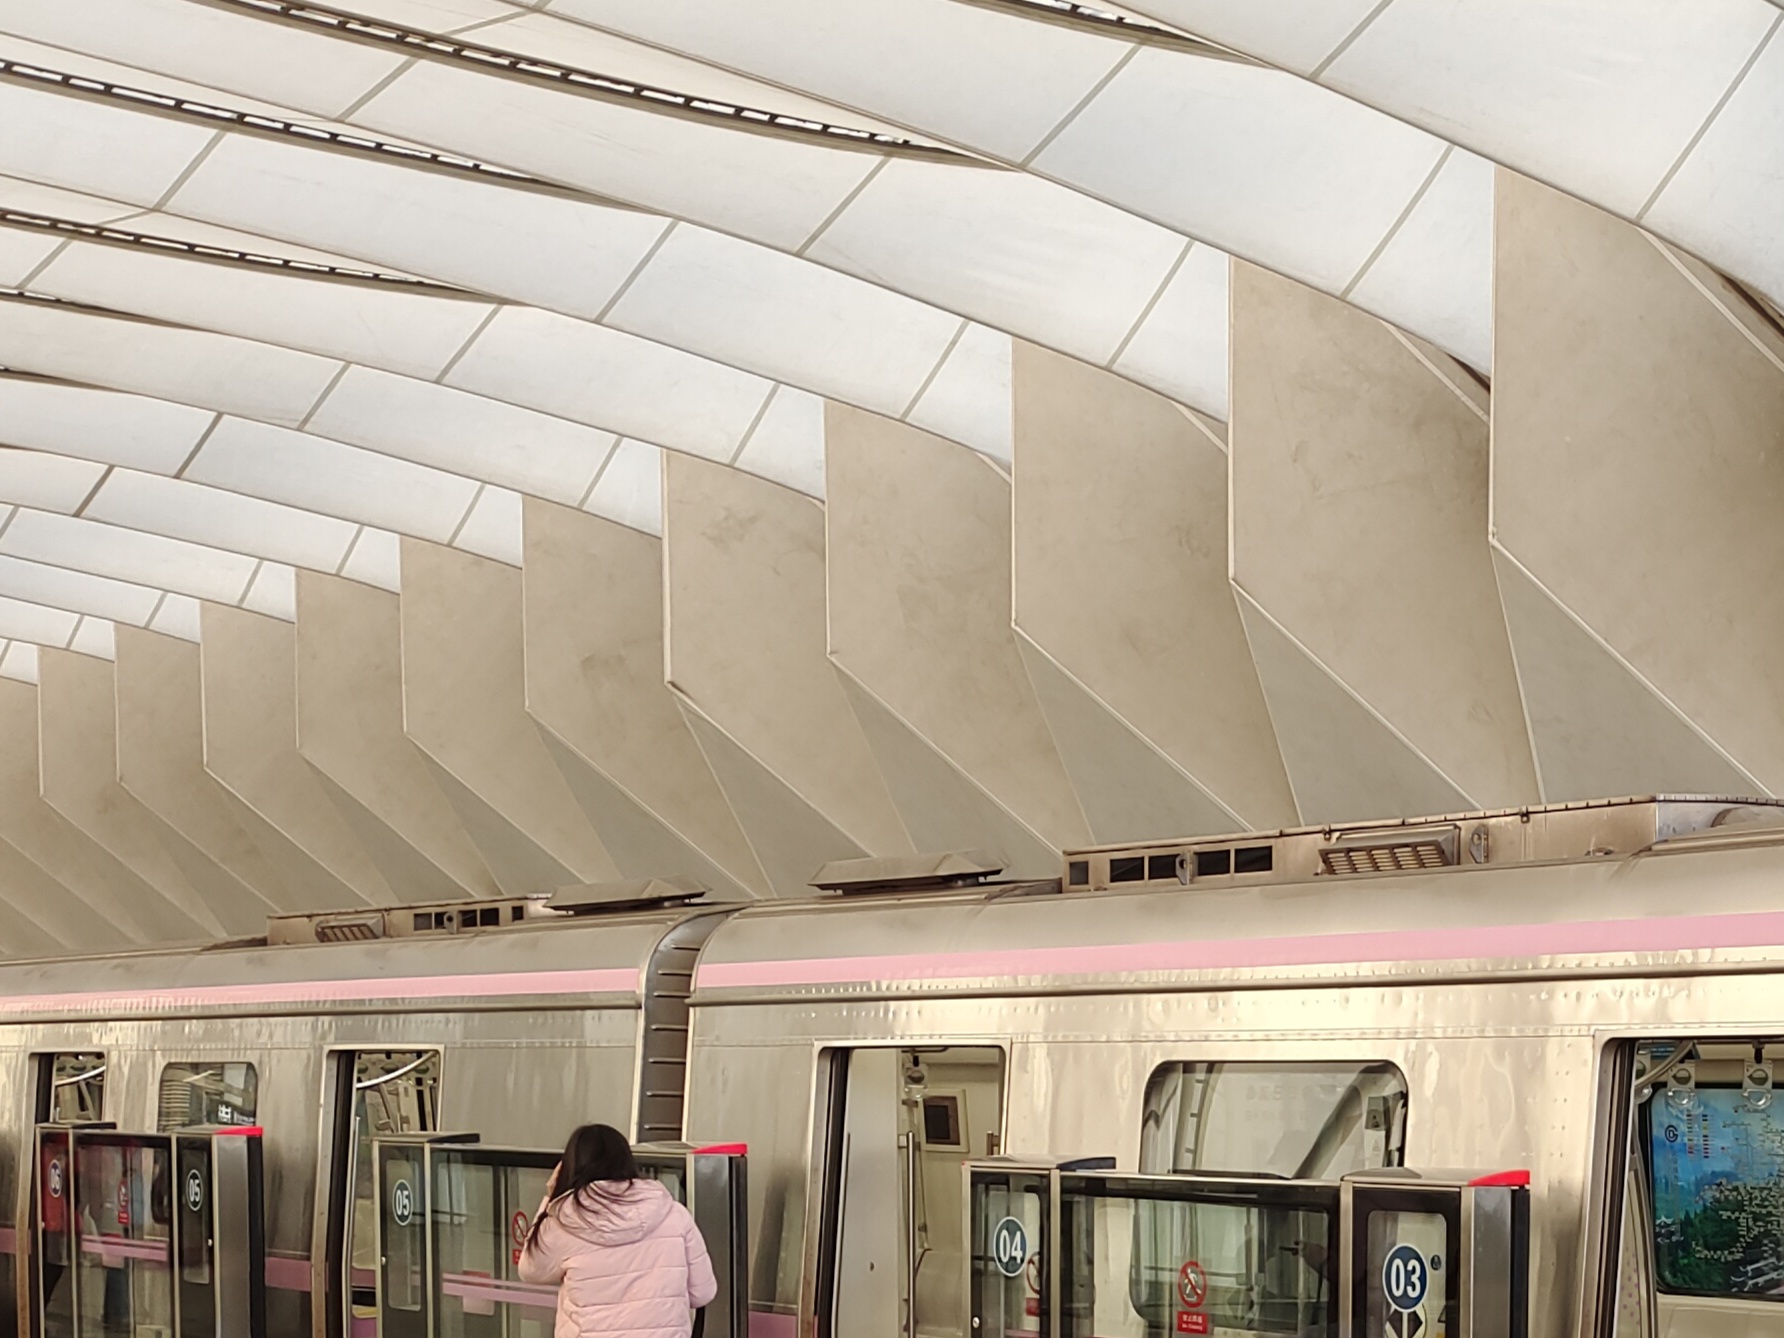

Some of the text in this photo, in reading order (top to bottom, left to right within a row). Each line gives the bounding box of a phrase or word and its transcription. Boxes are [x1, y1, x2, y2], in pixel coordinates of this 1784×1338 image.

[189, 1179, 201, 1202] 05
[395, 1189, 410, 1216] 05
[999, 1228, 1023, 1264] 04
[1390, 1257, 1422, 1299] 03
